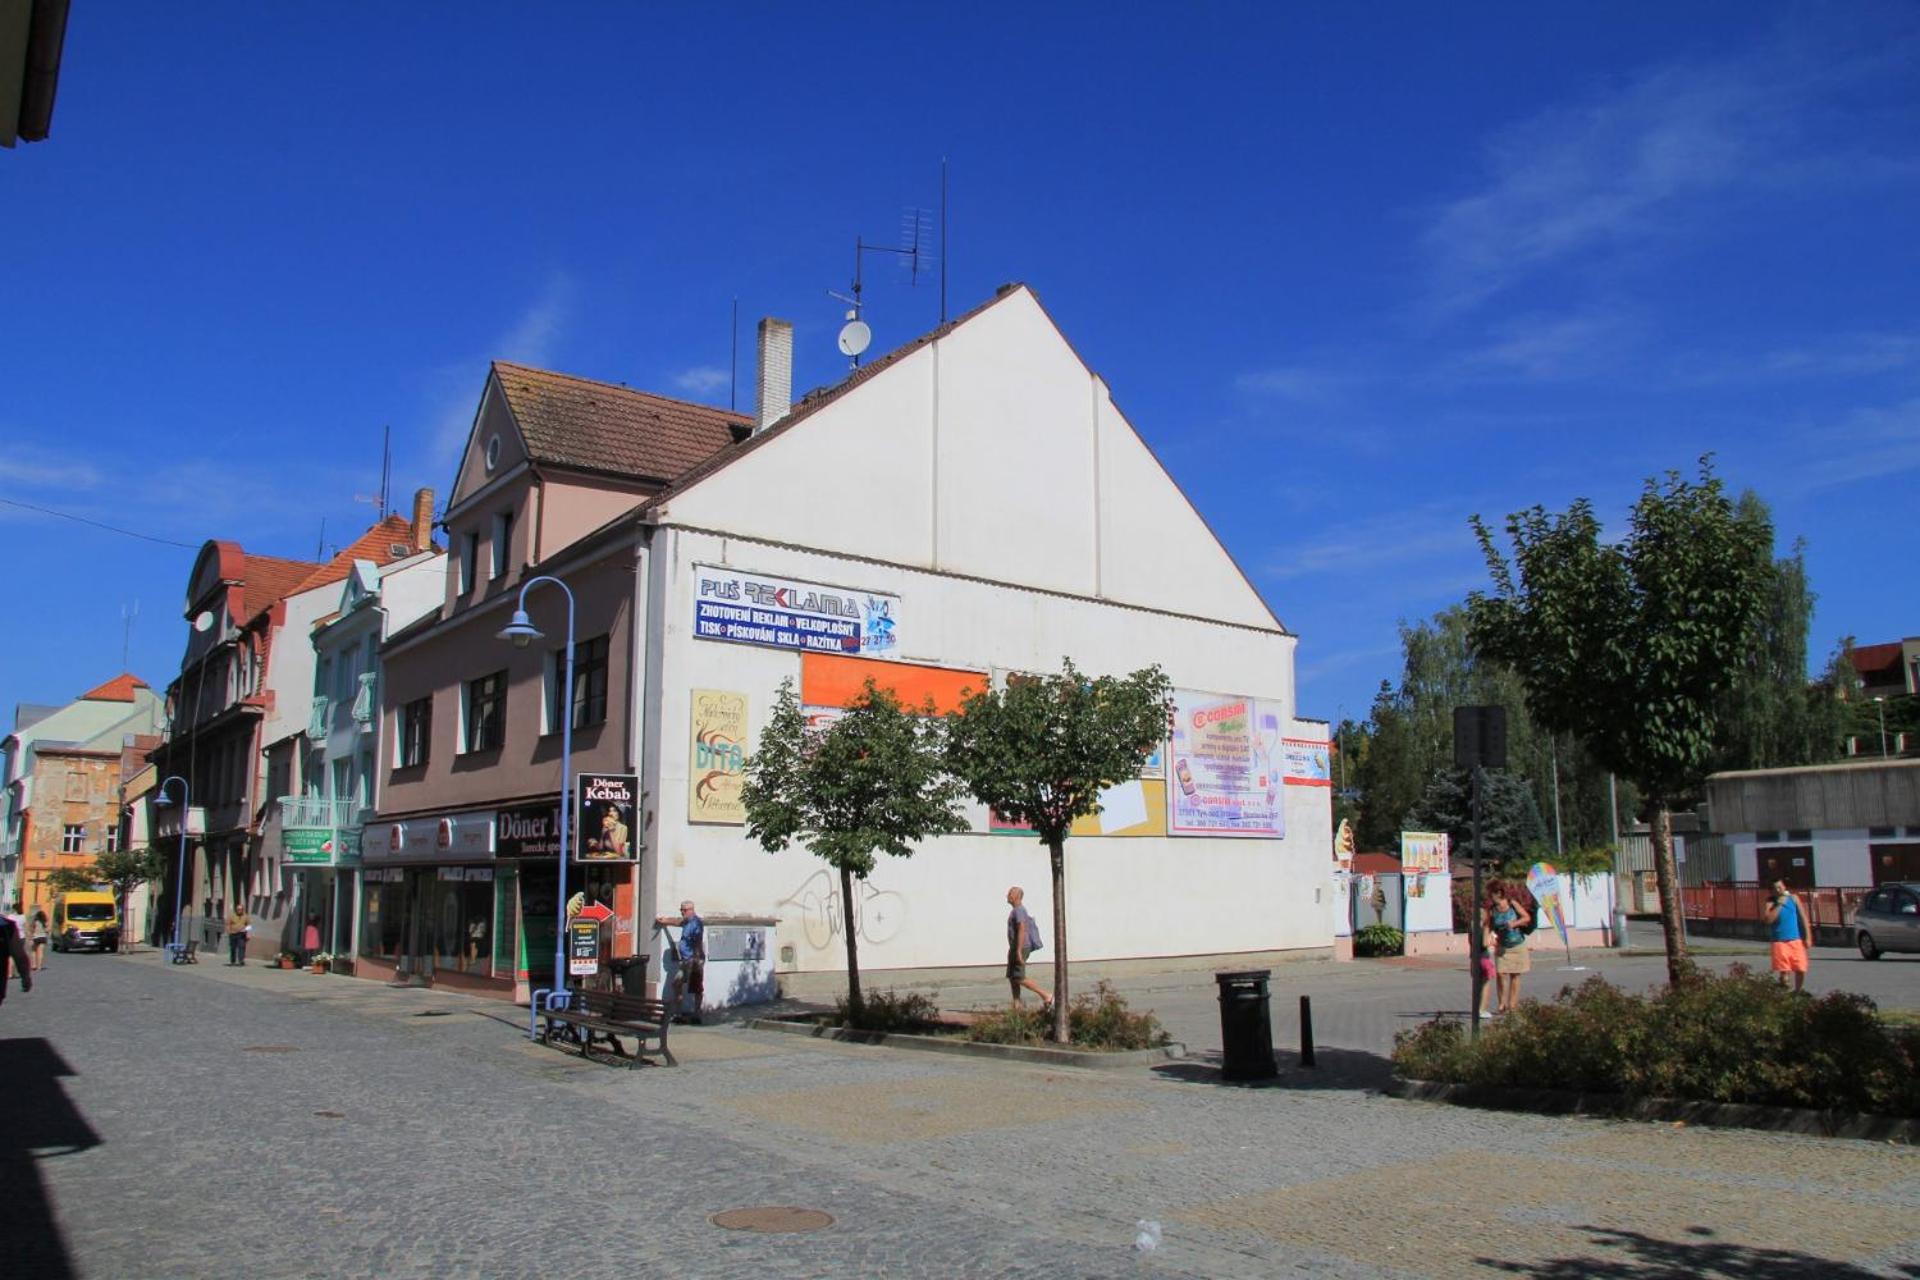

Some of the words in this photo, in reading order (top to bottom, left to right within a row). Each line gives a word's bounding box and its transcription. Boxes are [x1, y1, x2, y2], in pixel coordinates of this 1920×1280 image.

[752, 611, 788, 627] REKLAM
[700, 620, 721, 634] TISK
[777, 631, 800, 646] SKLA
[807, 634, 842, 651] RAZÍTKA
[696, 742, 744, 769] DITA
[585, 786, 631, 799] Kebab
[593, 778, 624, 788] Döner
[500, 812, 547, 839] Döner
